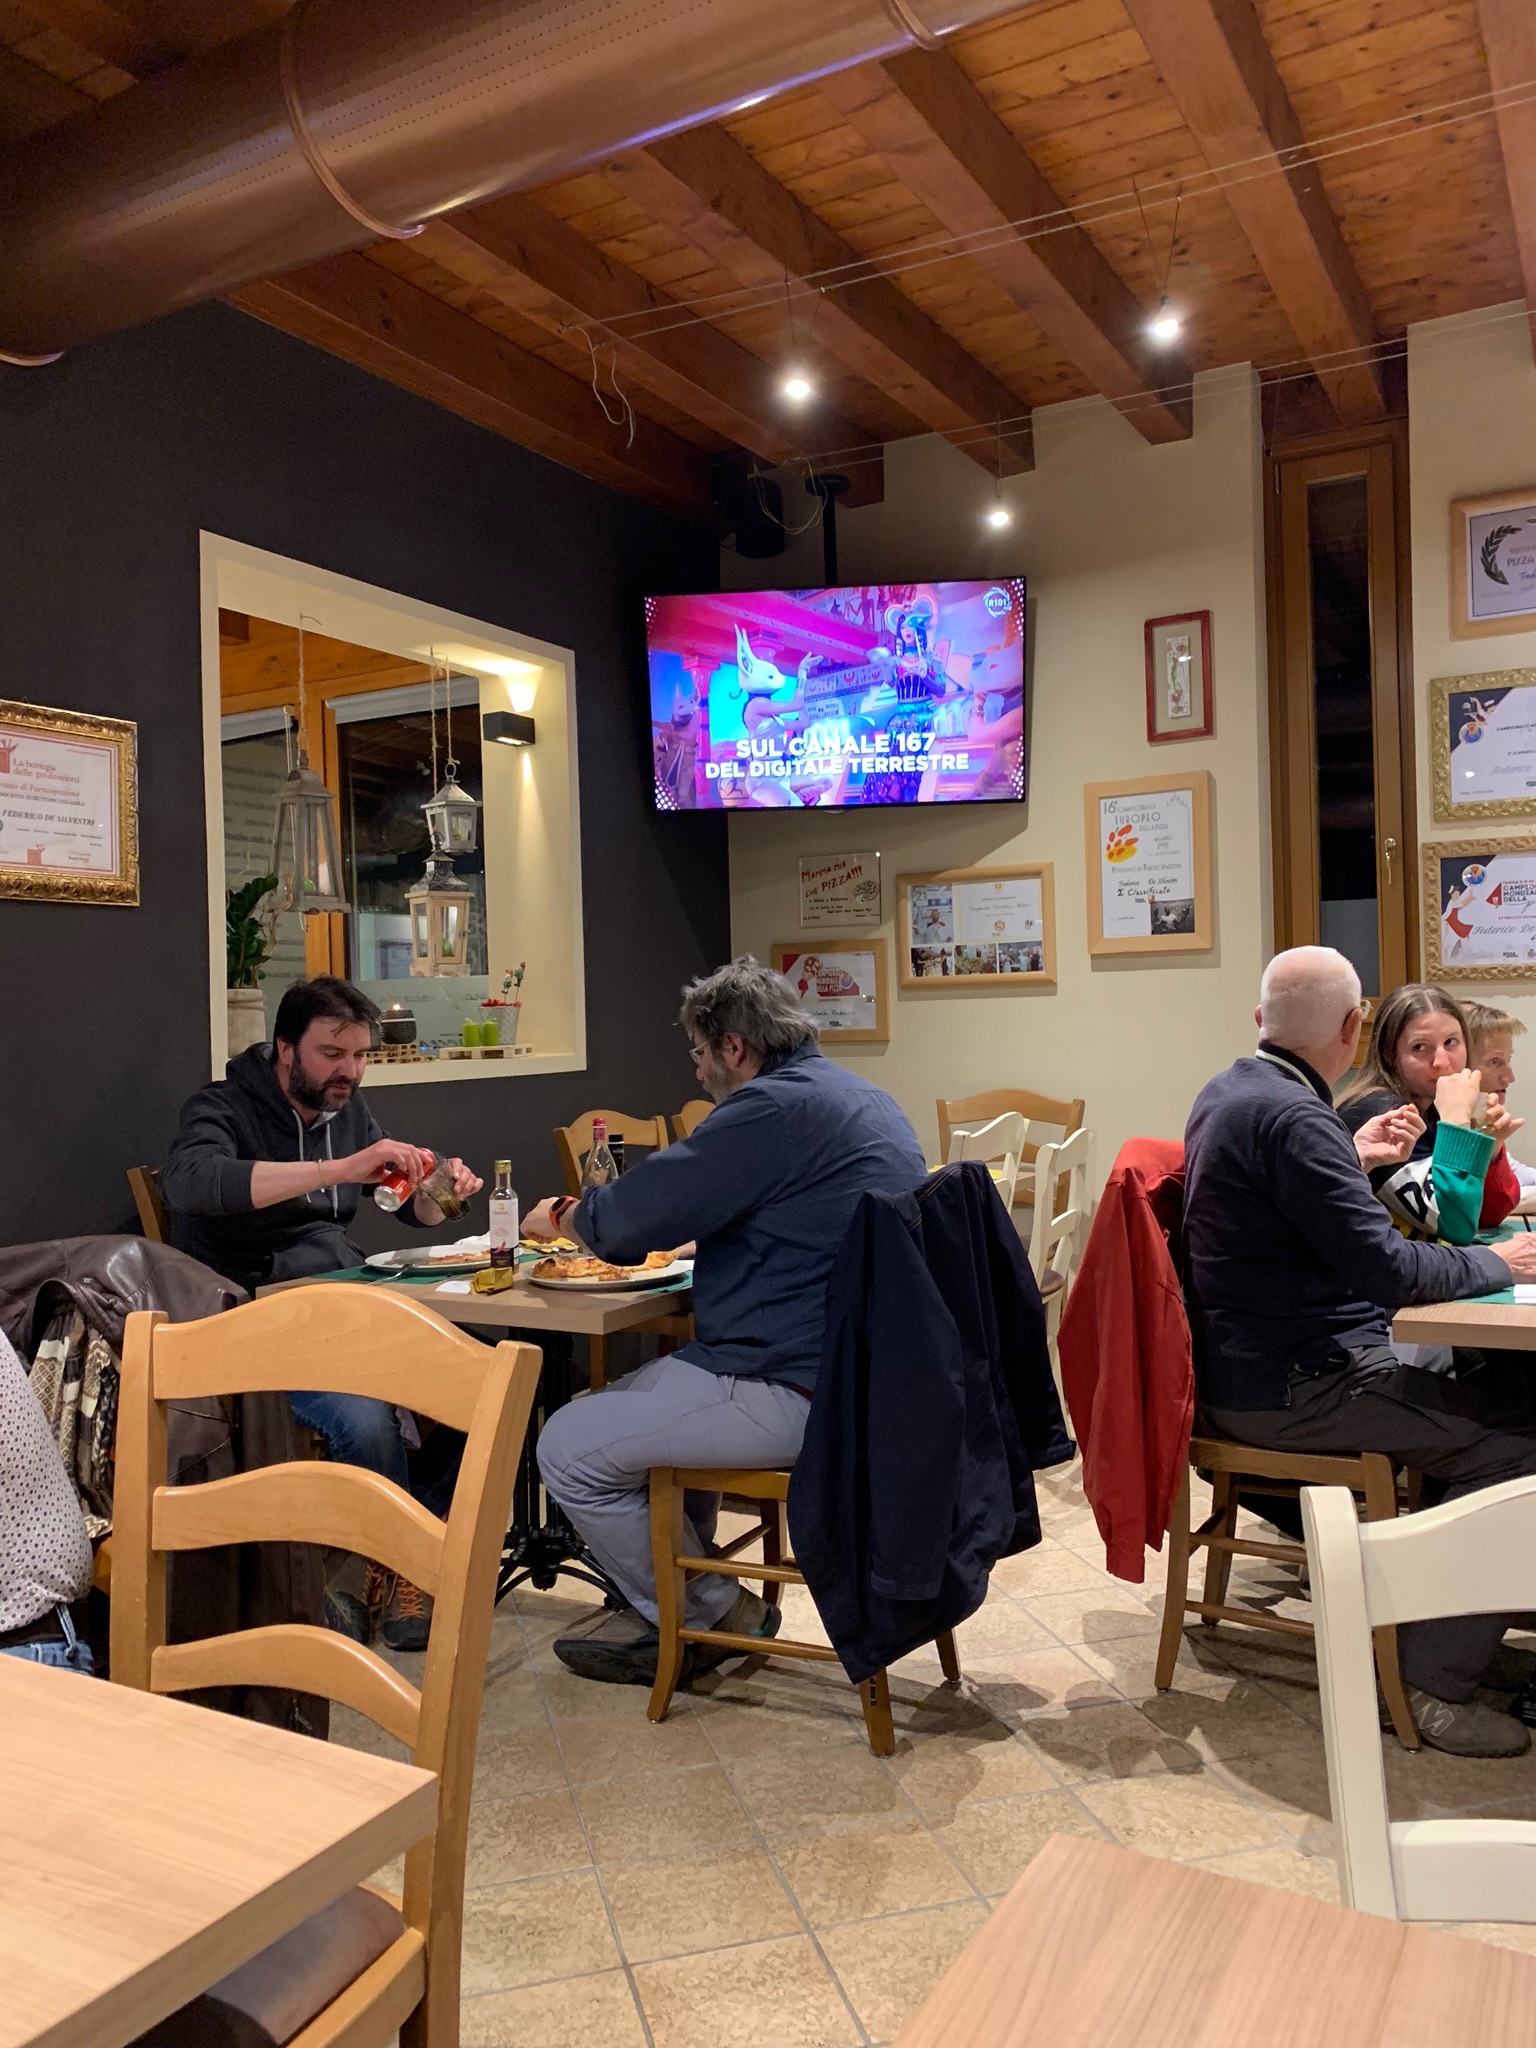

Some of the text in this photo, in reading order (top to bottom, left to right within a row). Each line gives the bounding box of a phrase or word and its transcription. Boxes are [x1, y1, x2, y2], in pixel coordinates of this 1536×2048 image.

[989, 598, 1007, 607] R101
[736, 732, 936, 758] SUL CANALE 167
[13, 758, 56, 771] La bottega
[705, 753, 970, 779] DEL DIGITALE TERRESTRE
[13, 768, 80, 783] delle professioni
[0, 781, 18, 789] stato
[2, 810, 95, 826] FEDERICO DE SILVESTRI
[1115, 812, 1161, 825] EUROPEO
[821, 865, 863, 891] PIZZA!!!
[1472, 924, 1536, 935] Federico De
